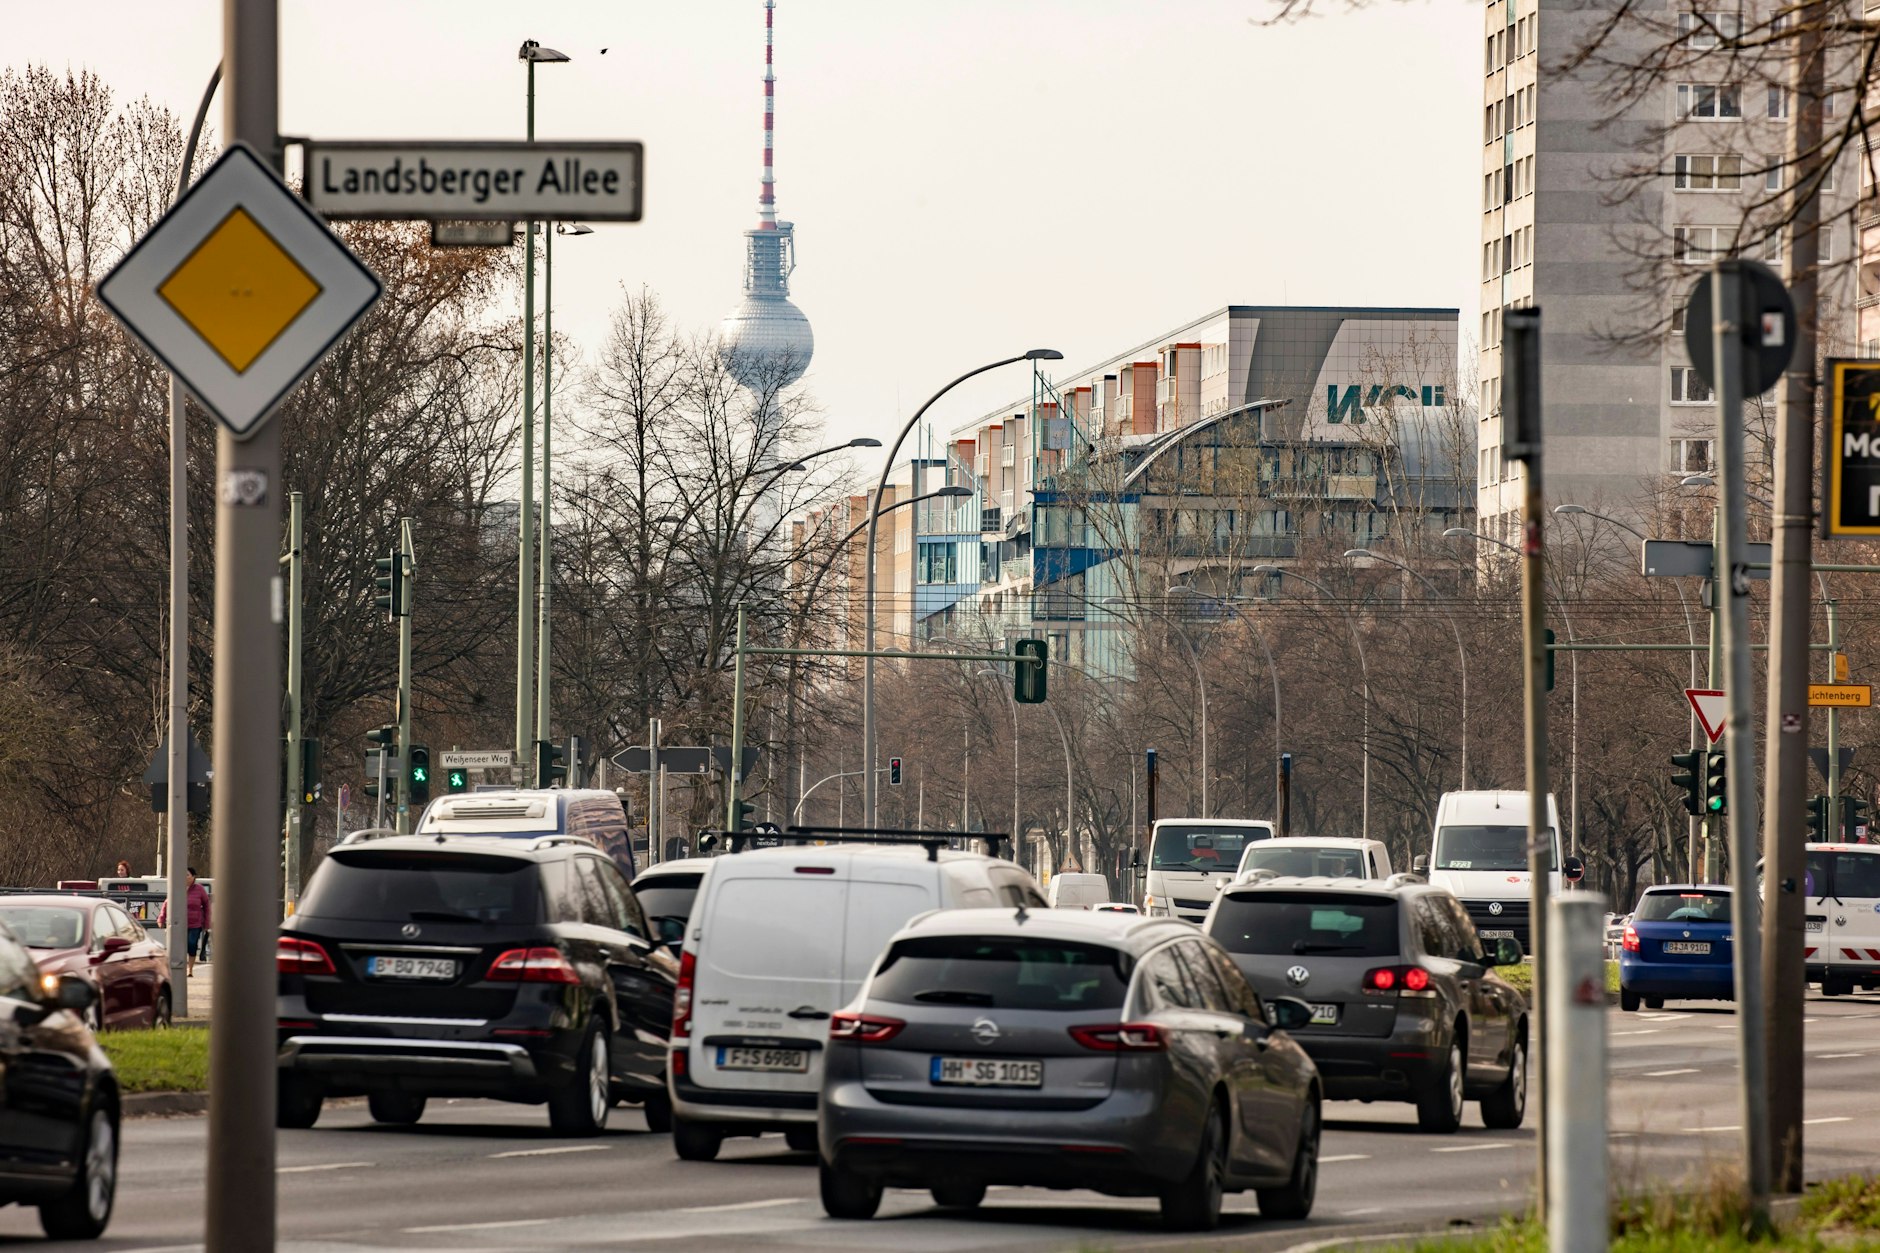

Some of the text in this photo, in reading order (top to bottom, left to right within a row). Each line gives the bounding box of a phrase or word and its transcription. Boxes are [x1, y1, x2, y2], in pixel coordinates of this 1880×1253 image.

[323, 157, 620, 203] Landsberger Allee
[1808, 691, 1861, 702] ichtenberg
[445, 754, 509, 765] Weißenseer Weg
[1690, 944, 1709, 952] 9101
[376, 959, 386, 973] B
[417, 961, 454, 976] 7948
[731, 1049, 802, 1067] F S 6980
[942, 1061, 1040, 1082] HH SG 1015
